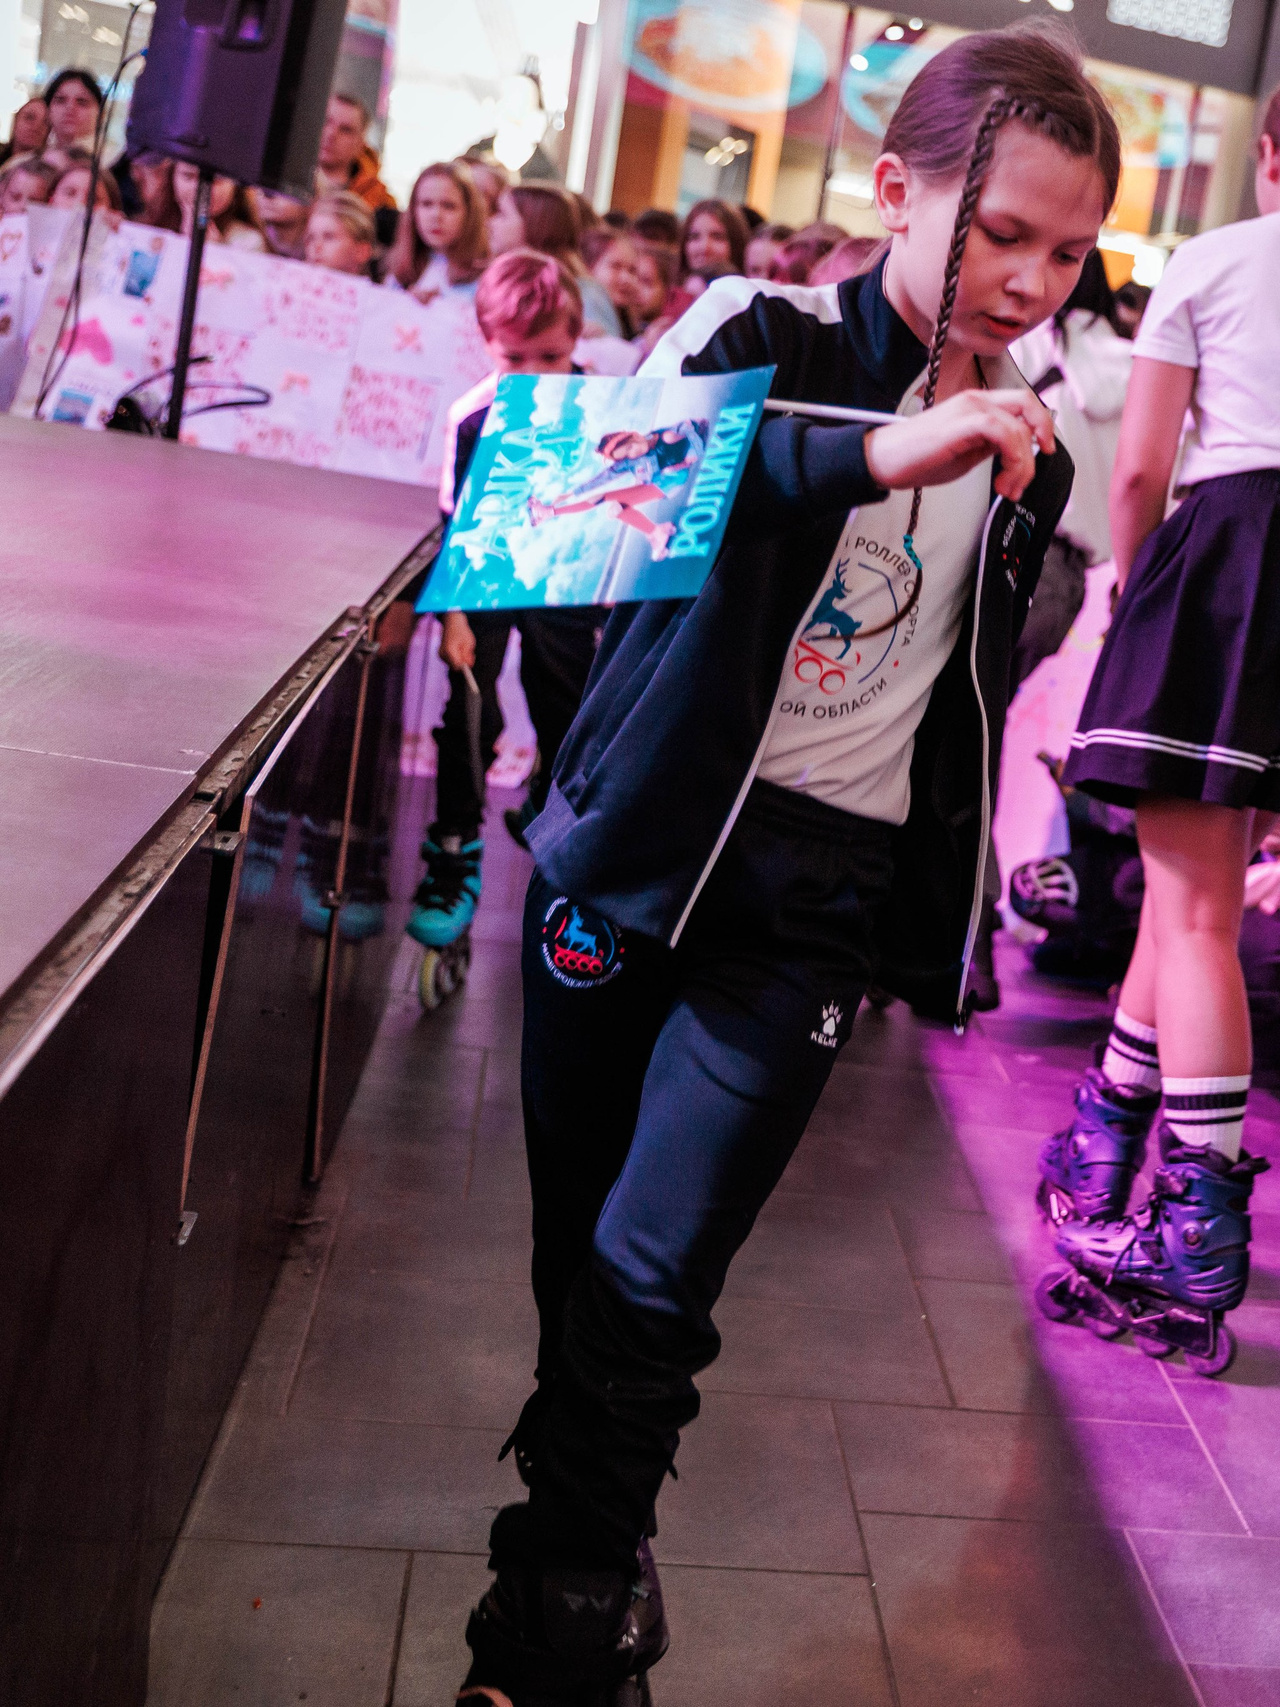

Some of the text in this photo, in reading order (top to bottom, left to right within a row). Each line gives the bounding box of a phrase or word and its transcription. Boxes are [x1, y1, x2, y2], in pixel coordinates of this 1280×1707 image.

[449, 420, 557, 560] ARIKA
[667, 402, 756, 558] РОЛИКИ
[901, 580, 919, 648] СОРТА
[813, 677, 888, 719] ОБЛАСТИ
